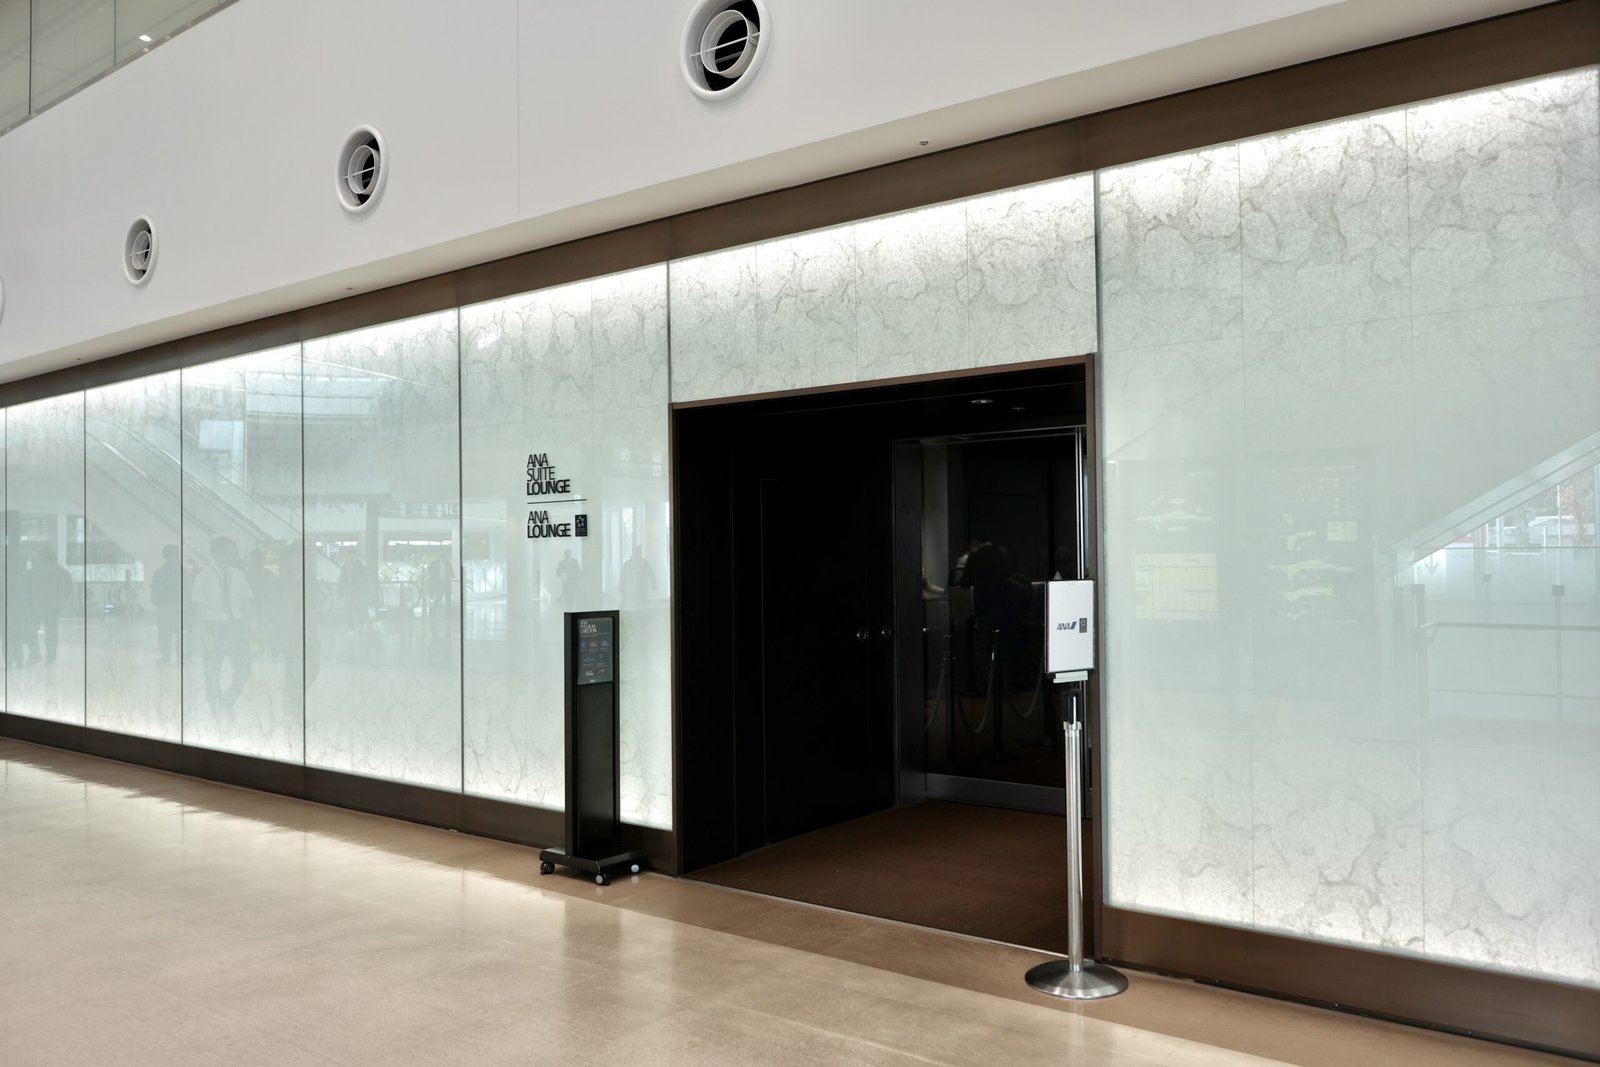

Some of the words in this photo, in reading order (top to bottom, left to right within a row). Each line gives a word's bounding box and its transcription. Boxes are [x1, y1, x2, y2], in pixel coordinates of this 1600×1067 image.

[527, 453, 549, 468] ANA
[527, 466, 555, 482] SUITE
[527, 479, 570, 496] LOUNGE
[527, 510, 549, 524] ANA
[527, 523, 571, 538] LOUNGE
[1056, 622, 1072, 630] ANA
